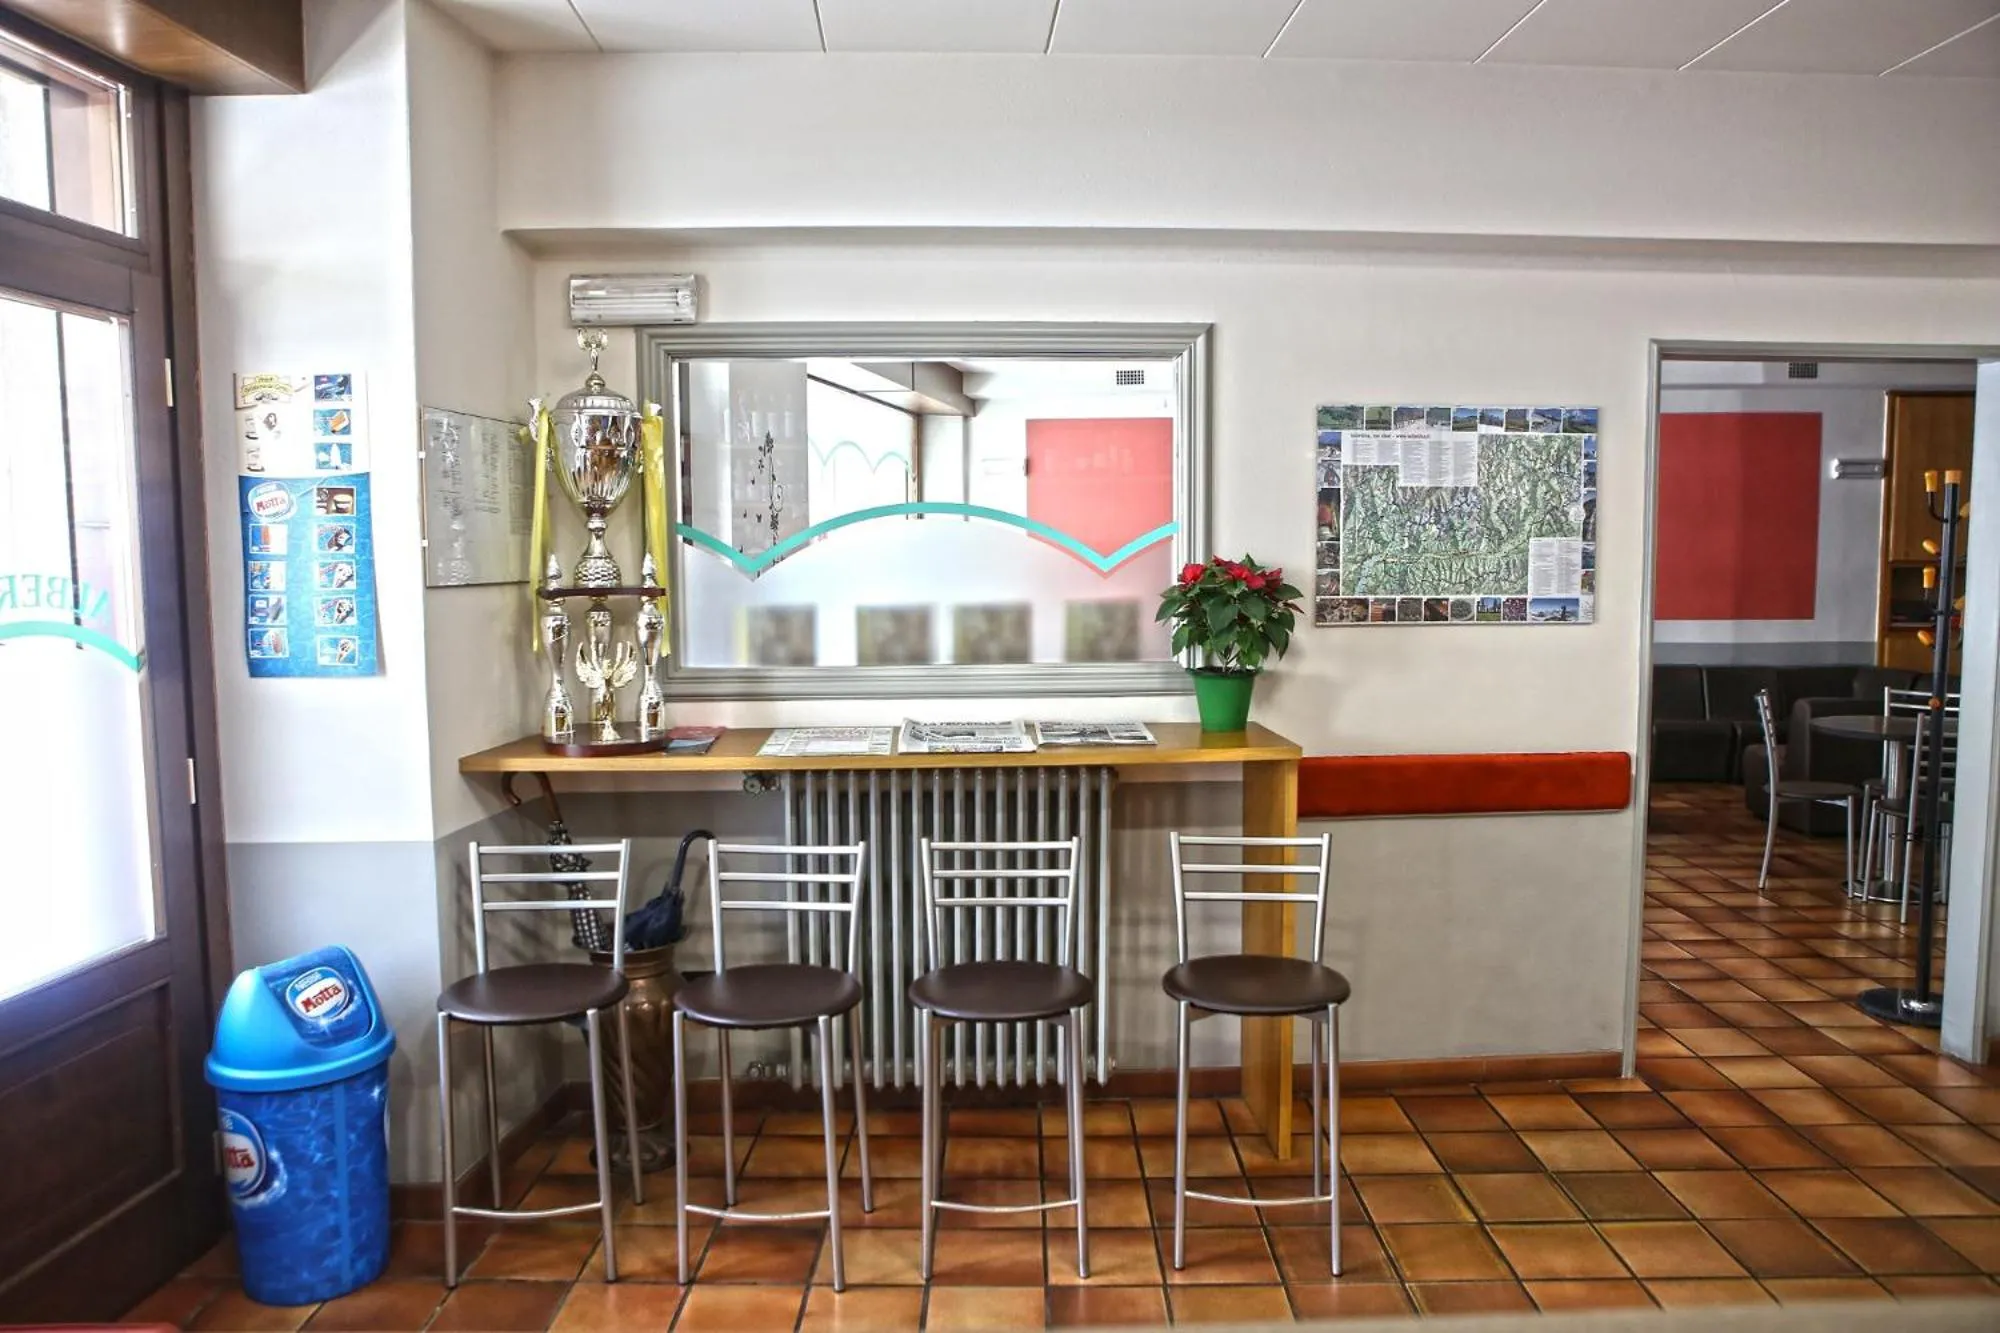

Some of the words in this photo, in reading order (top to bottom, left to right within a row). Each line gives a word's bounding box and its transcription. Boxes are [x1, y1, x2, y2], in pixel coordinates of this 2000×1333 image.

[255, 497, 287, 512] Motta
[301, 983, 343, 1013] Motta
[224, 1146, 256, 1169] tta
